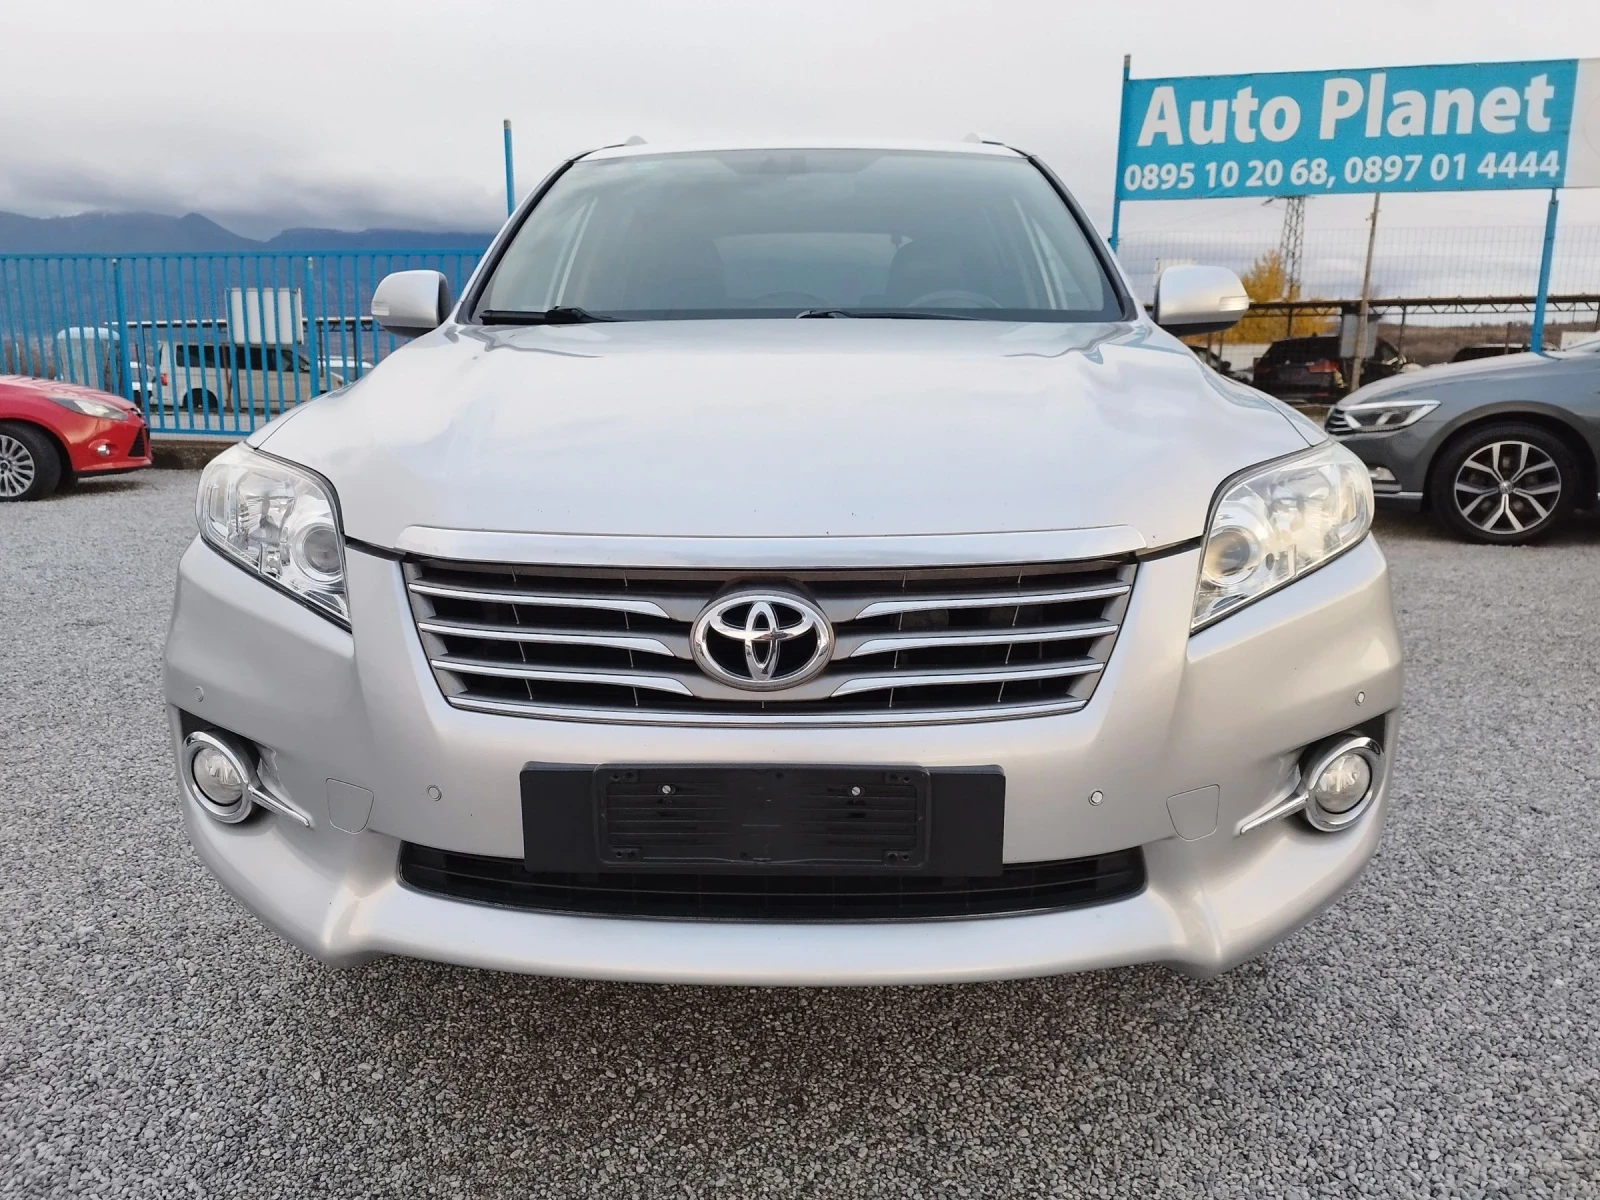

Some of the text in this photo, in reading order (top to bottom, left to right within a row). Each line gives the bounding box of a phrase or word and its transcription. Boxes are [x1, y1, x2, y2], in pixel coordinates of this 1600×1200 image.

[1137, 72, 1556, 147] Auto Planet
[1123, 150, 1560, 191] 0895 10 20 68, 0897 01 4444
